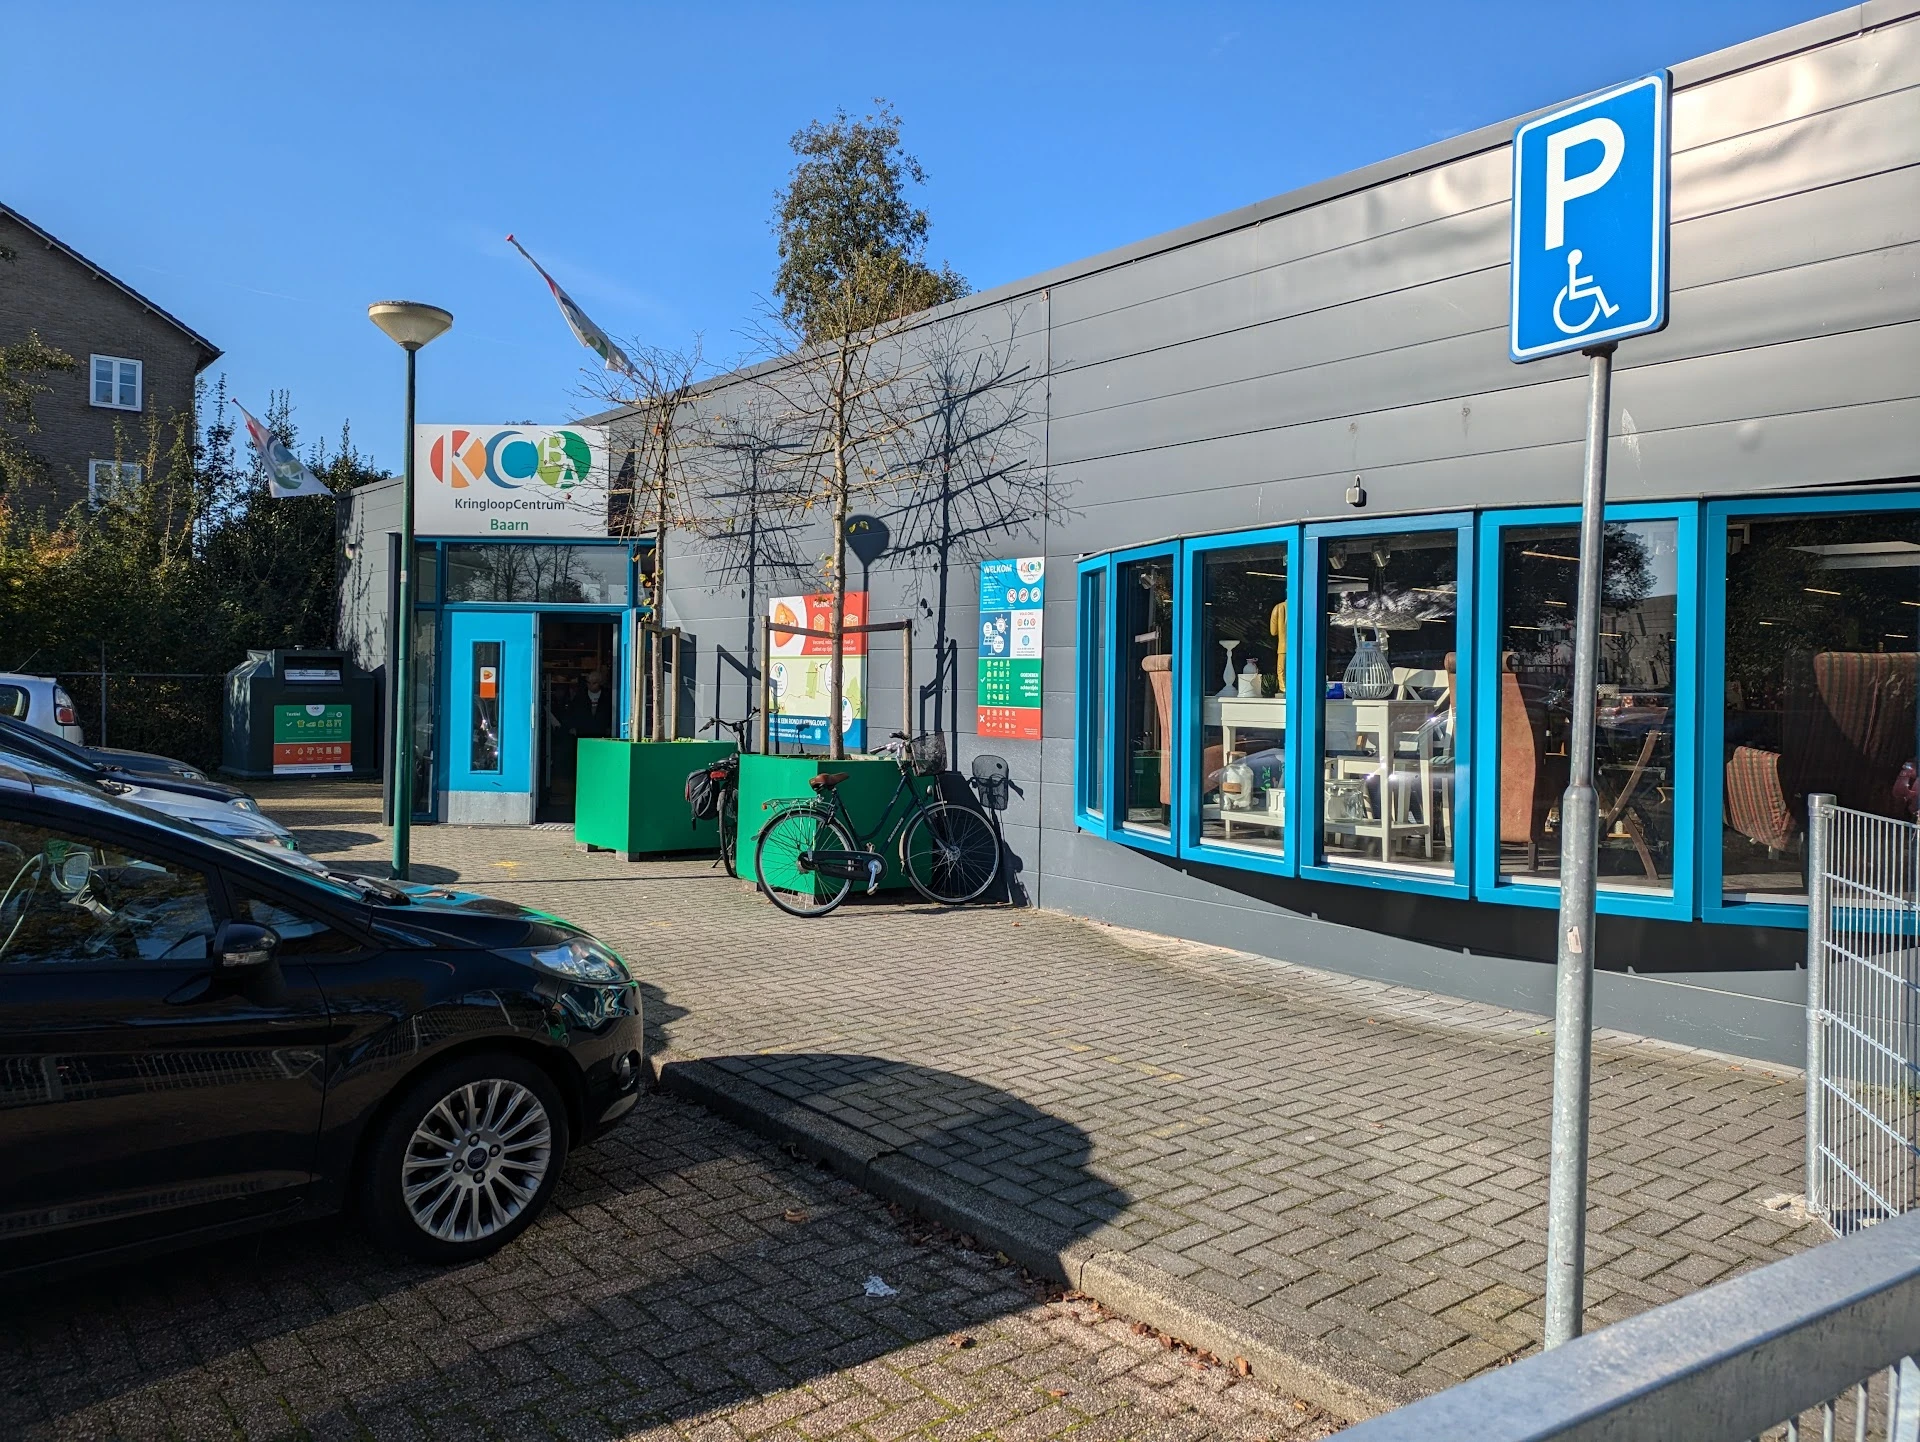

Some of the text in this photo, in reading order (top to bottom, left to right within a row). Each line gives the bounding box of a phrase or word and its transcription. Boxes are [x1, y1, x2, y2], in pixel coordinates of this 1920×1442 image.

[1545, 117, 1625, 251] P
[454, 498, 565, 512] KringloopCentrum
[490, 518, 529, 531] Baarn
[983, 564, 1013, 574] WELKOM
